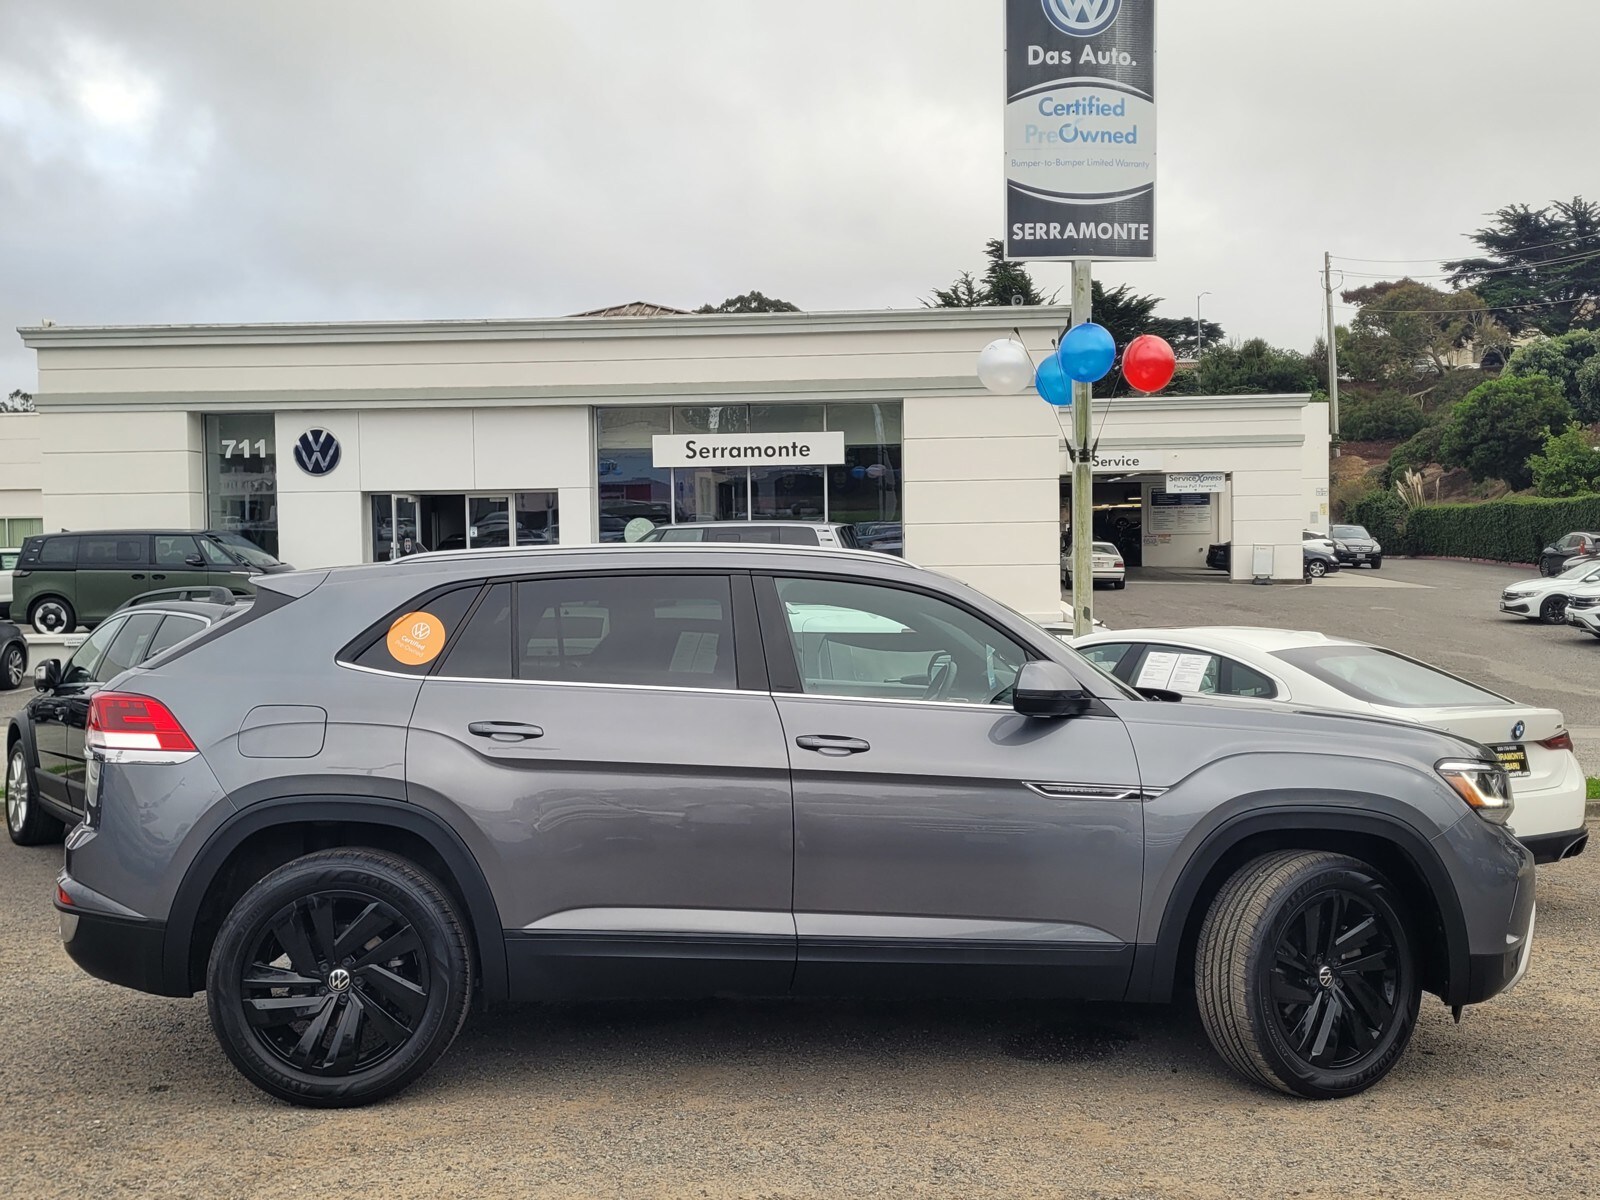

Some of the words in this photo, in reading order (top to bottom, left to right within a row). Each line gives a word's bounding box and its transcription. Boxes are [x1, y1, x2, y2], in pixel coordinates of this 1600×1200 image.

[1027, 45, 1072, 66] Das
[1079, 45, 1138, 67] Auto.
[1038, 95, 1126, 117] Certified
[1011, 159, 1085, 169] Bumper-to-Bumper
[1087, 159, 1114, 168] Limited
[1116, 159, 1150, 170] Warranty
[1012, 222, 1149, 241] SERRAMONTE
[221, 438, 266, 459] 711
[685, 440, 811, 460] Serramonte
[1092, 455, 1140, 467] Service
[1169, 474, 1223, 483] ServiceXpress
[402, 635, 426, 650] Certified
